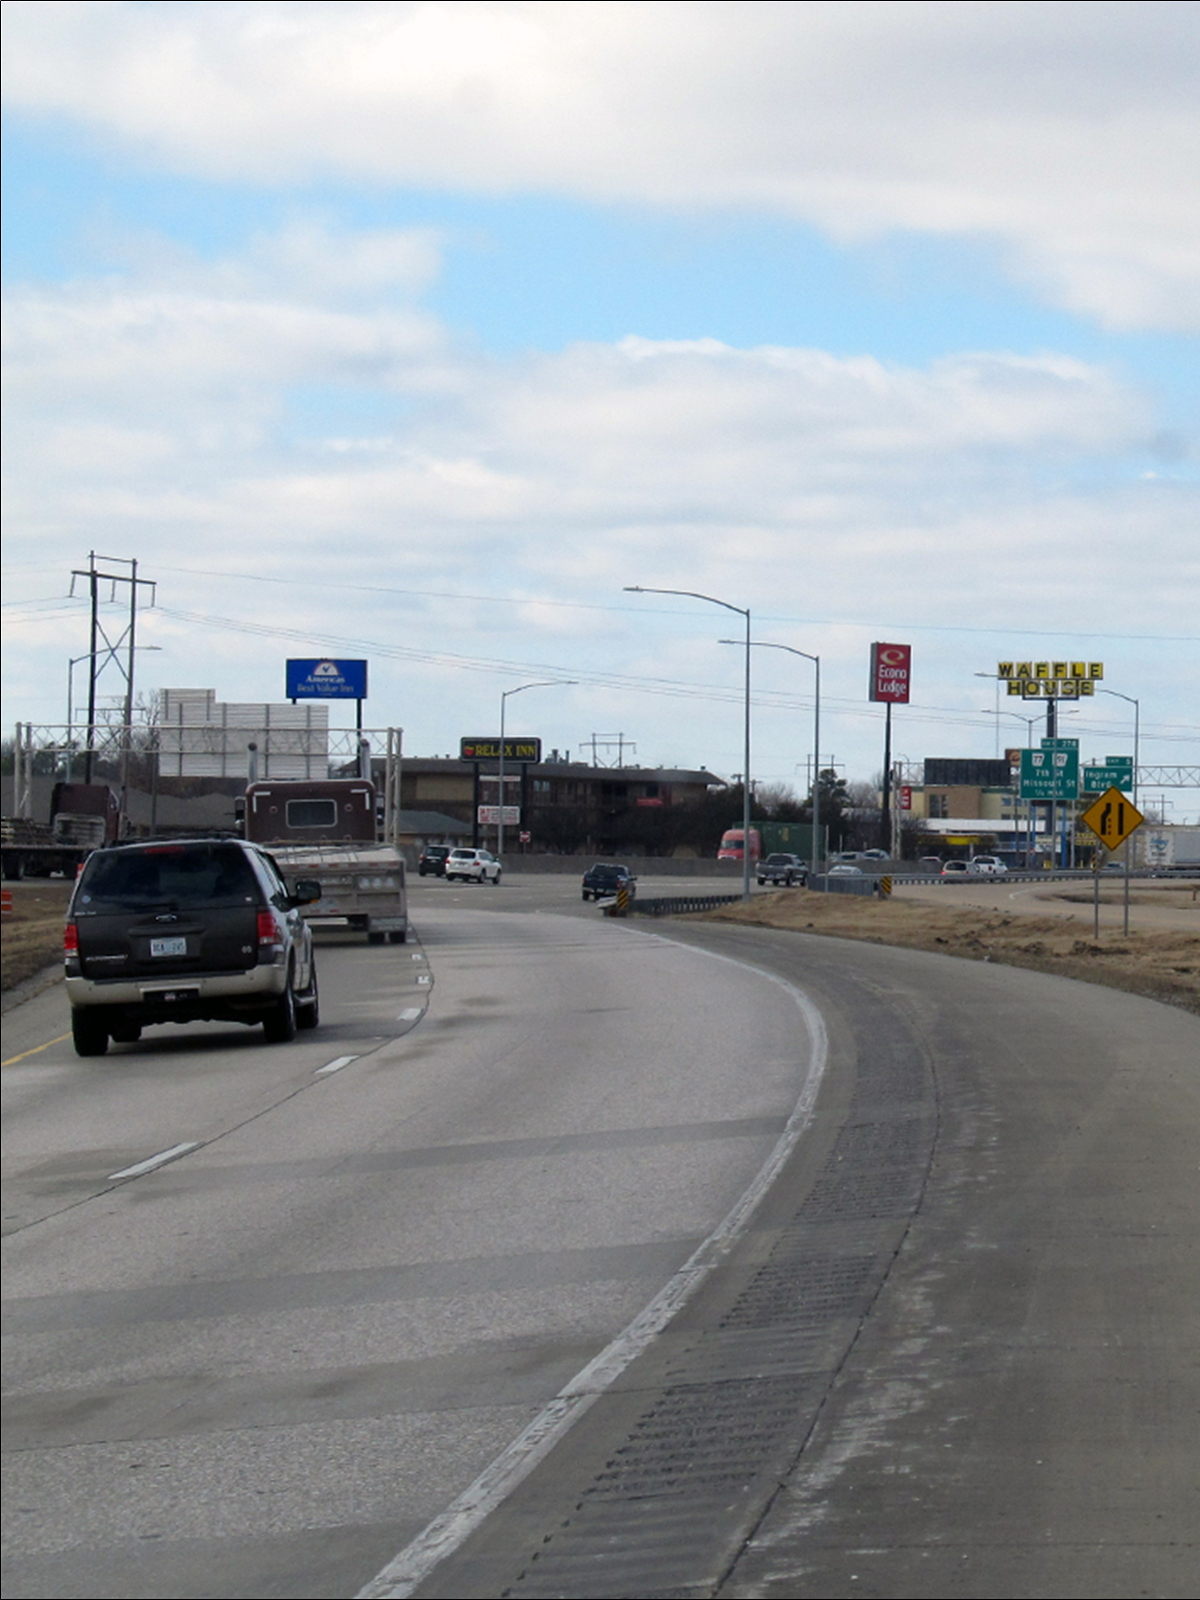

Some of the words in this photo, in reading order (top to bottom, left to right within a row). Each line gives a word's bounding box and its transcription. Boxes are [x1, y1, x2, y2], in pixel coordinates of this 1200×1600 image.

[878, 664, 908, 679] Econo
[998, 662, 1101, 678] WAFFLE
[297, 683, 315, 693] Best
[316, 683, 338, 693] Value
[340, 683, 354, 693] Inn
[878, 679, 907, 698] Lodge
[1007, 680, 1092, 696] HOUSE
[516, 744, 536, 757] INN
[1035, 769, 1050, 777] 7th
[1085, 770, 1118, 780] Ingram
[1023, 779, 1062, 788] Missouri
[1066, 779, 1076, 788] St
